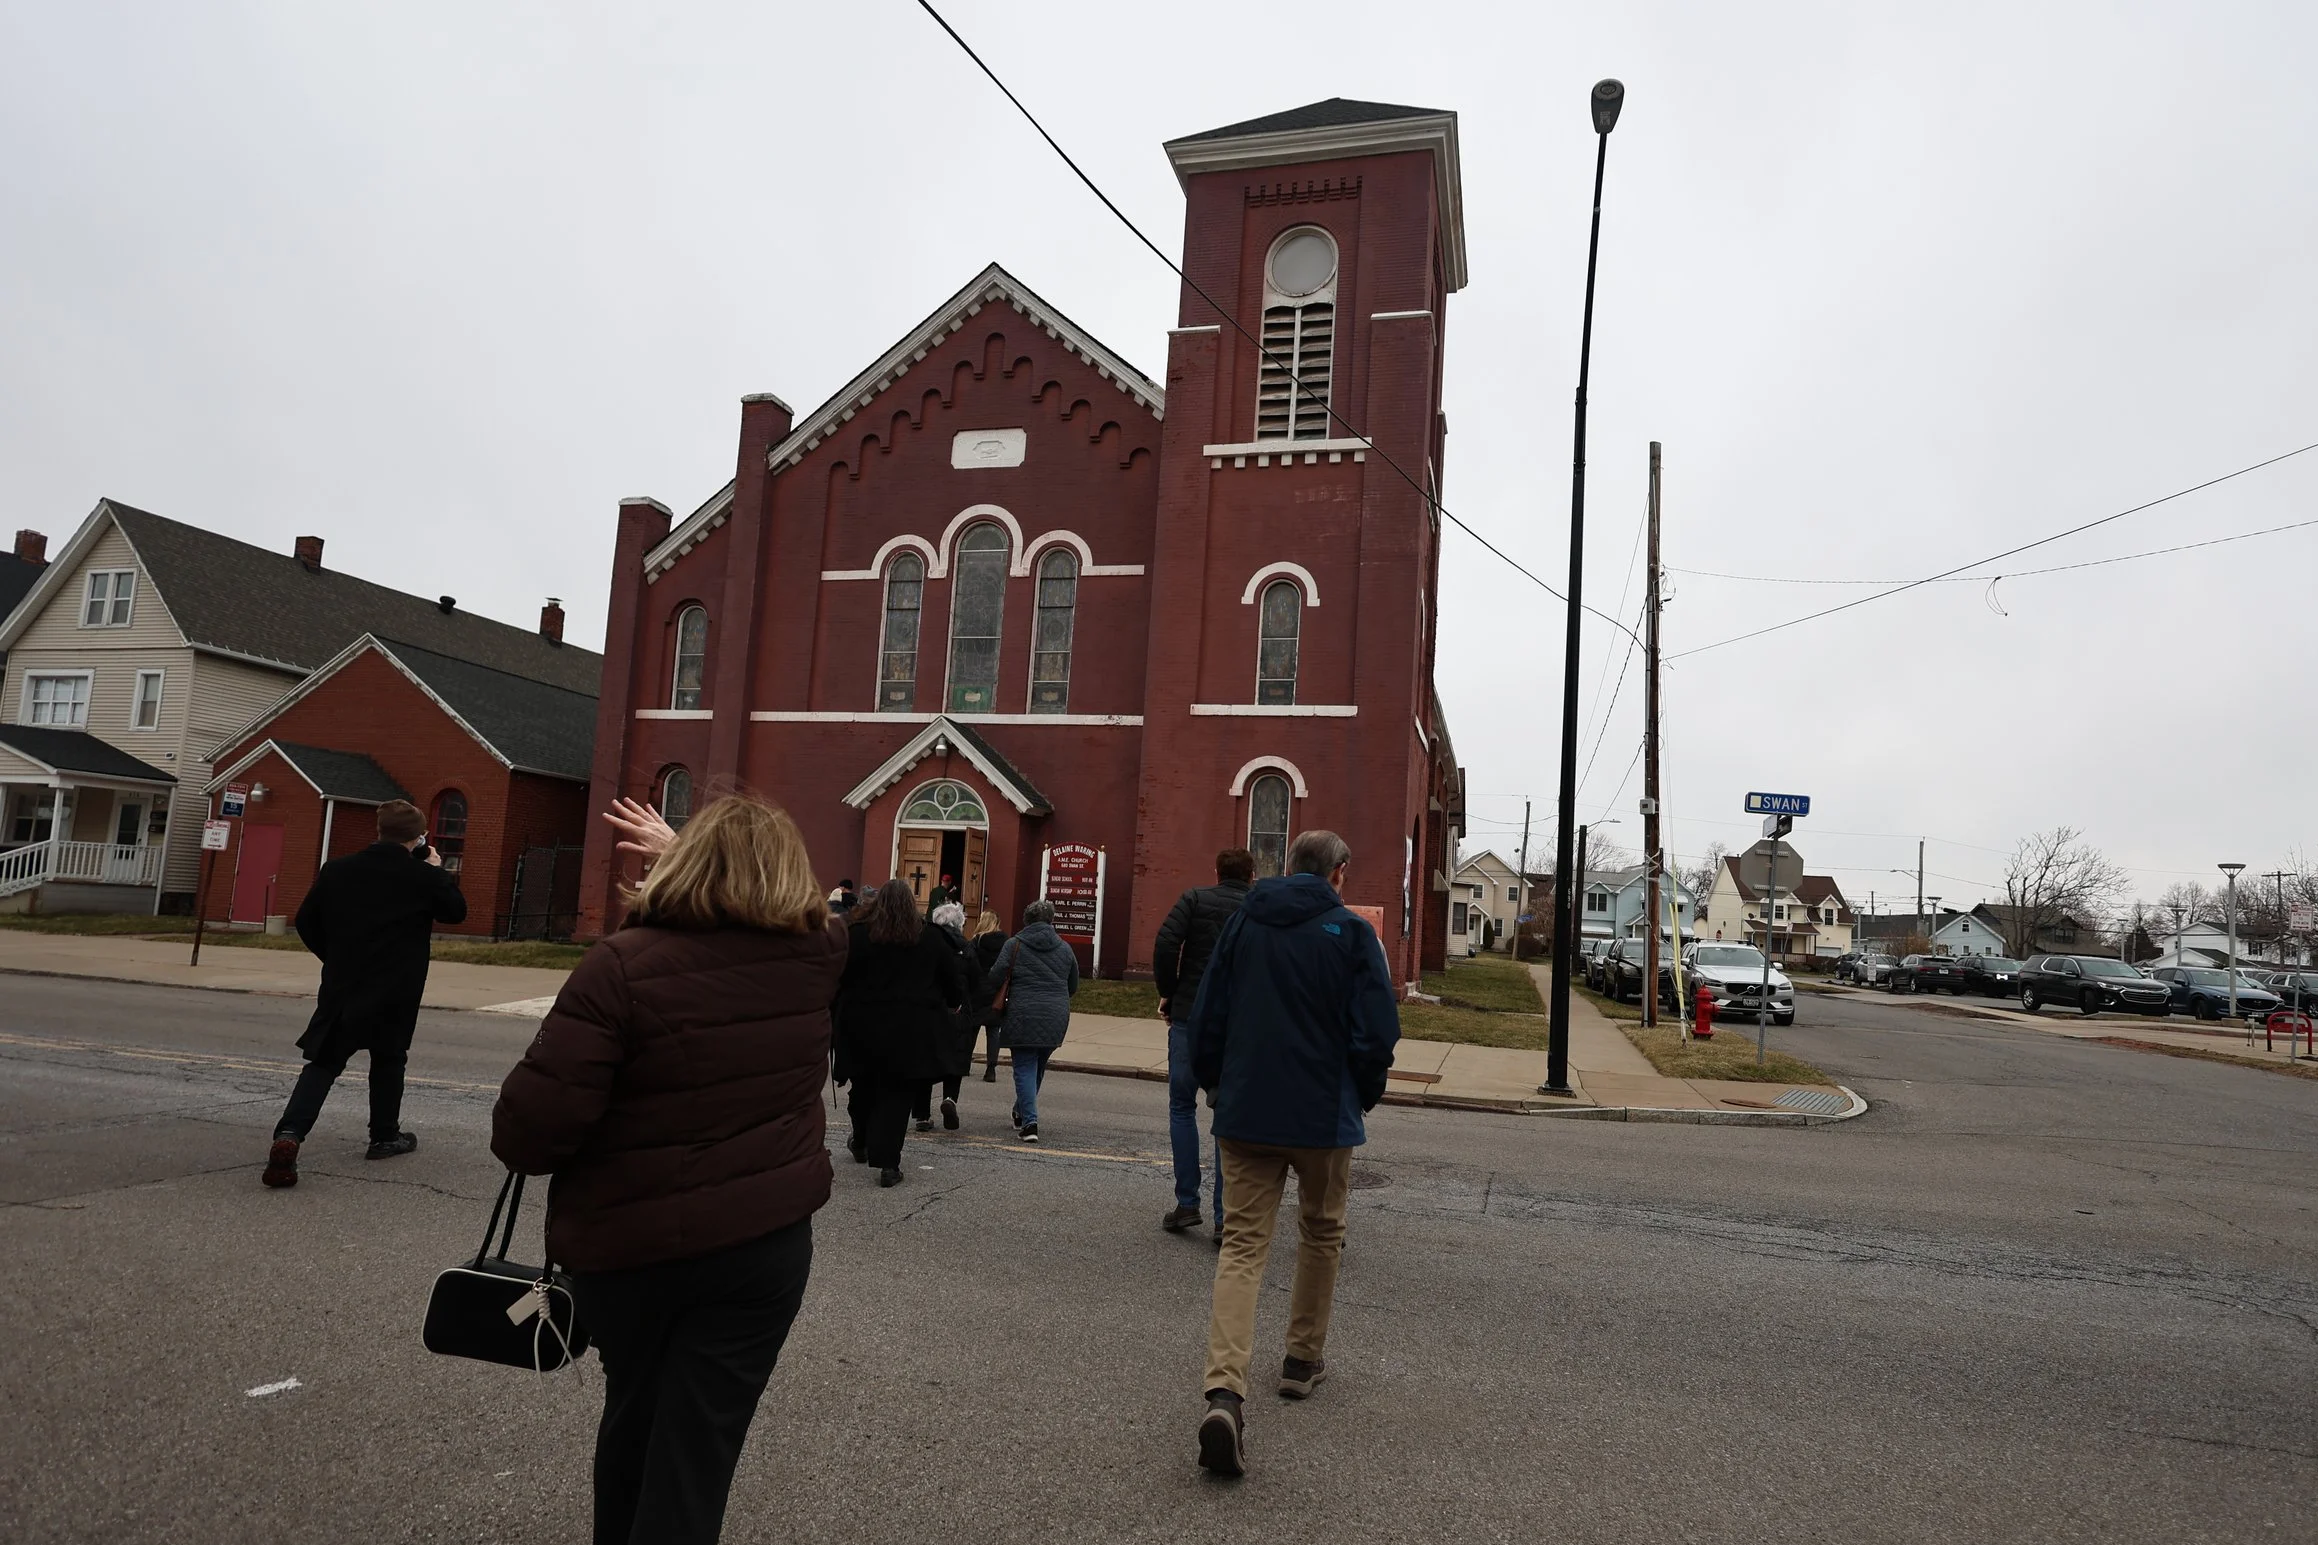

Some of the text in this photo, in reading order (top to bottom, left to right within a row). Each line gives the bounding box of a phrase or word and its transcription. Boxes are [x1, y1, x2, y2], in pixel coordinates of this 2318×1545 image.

[1763, 796, 1800, 811] SWAN
[1052, 844, 1096, 858] DELAINE WARING
